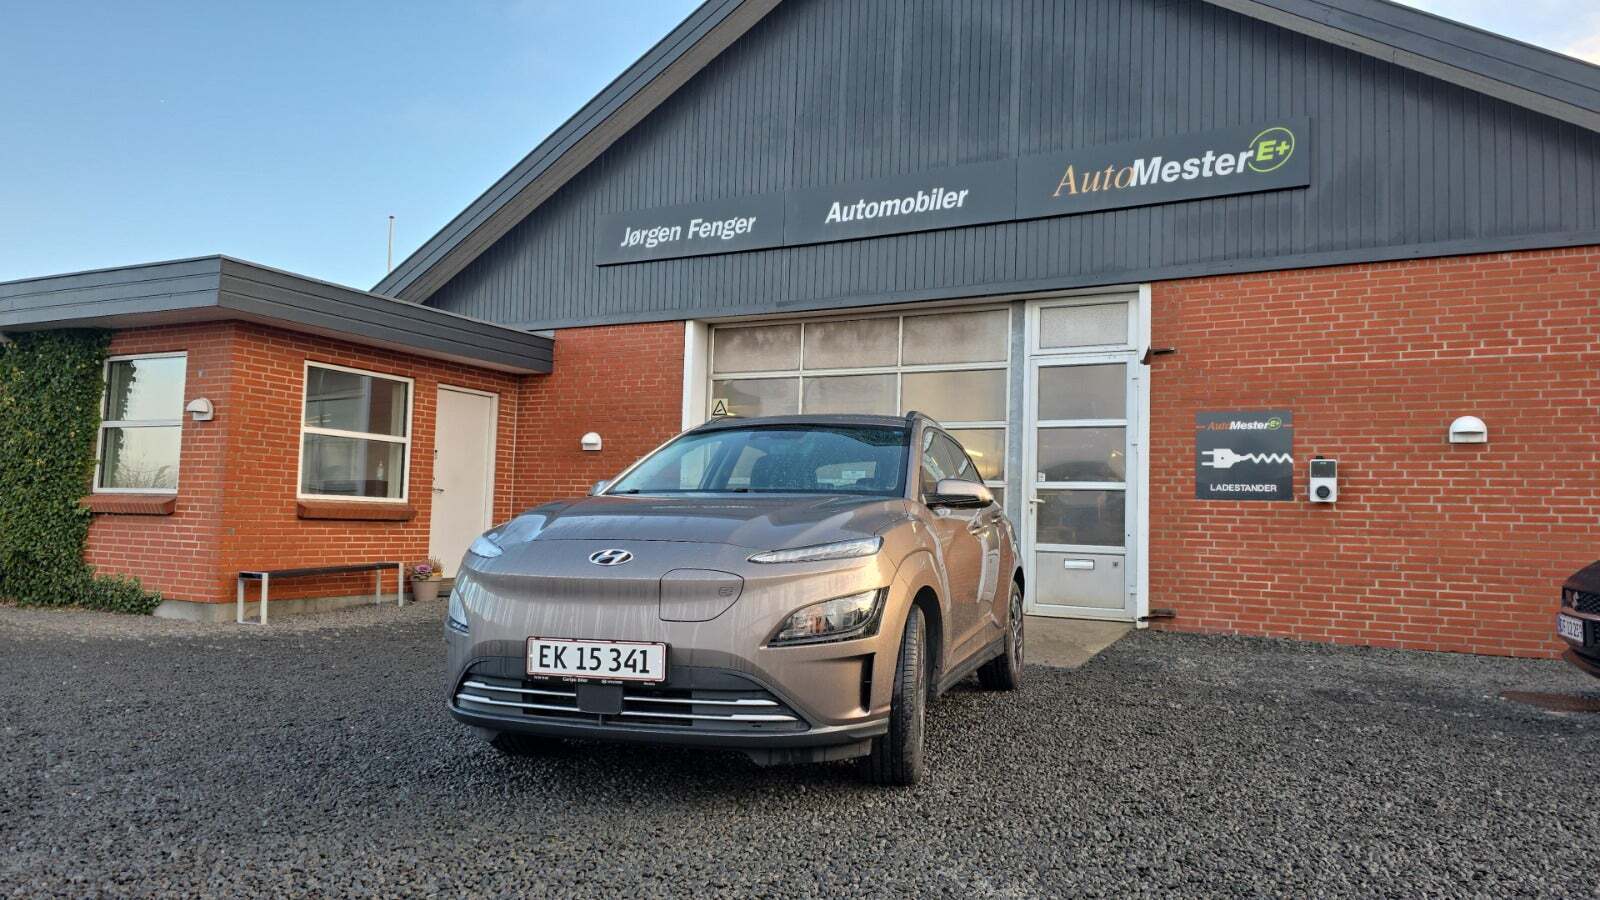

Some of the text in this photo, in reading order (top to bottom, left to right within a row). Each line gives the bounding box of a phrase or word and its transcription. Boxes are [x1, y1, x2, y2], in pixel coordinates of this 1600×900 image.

[824, 187, 969, 225] Automobiler
[620, 215, 757, 248] Jørgen Fenger
[1210, 483, 1277, 493] LADESTANDER
[539, 644, 650, 674] EK 15 341
